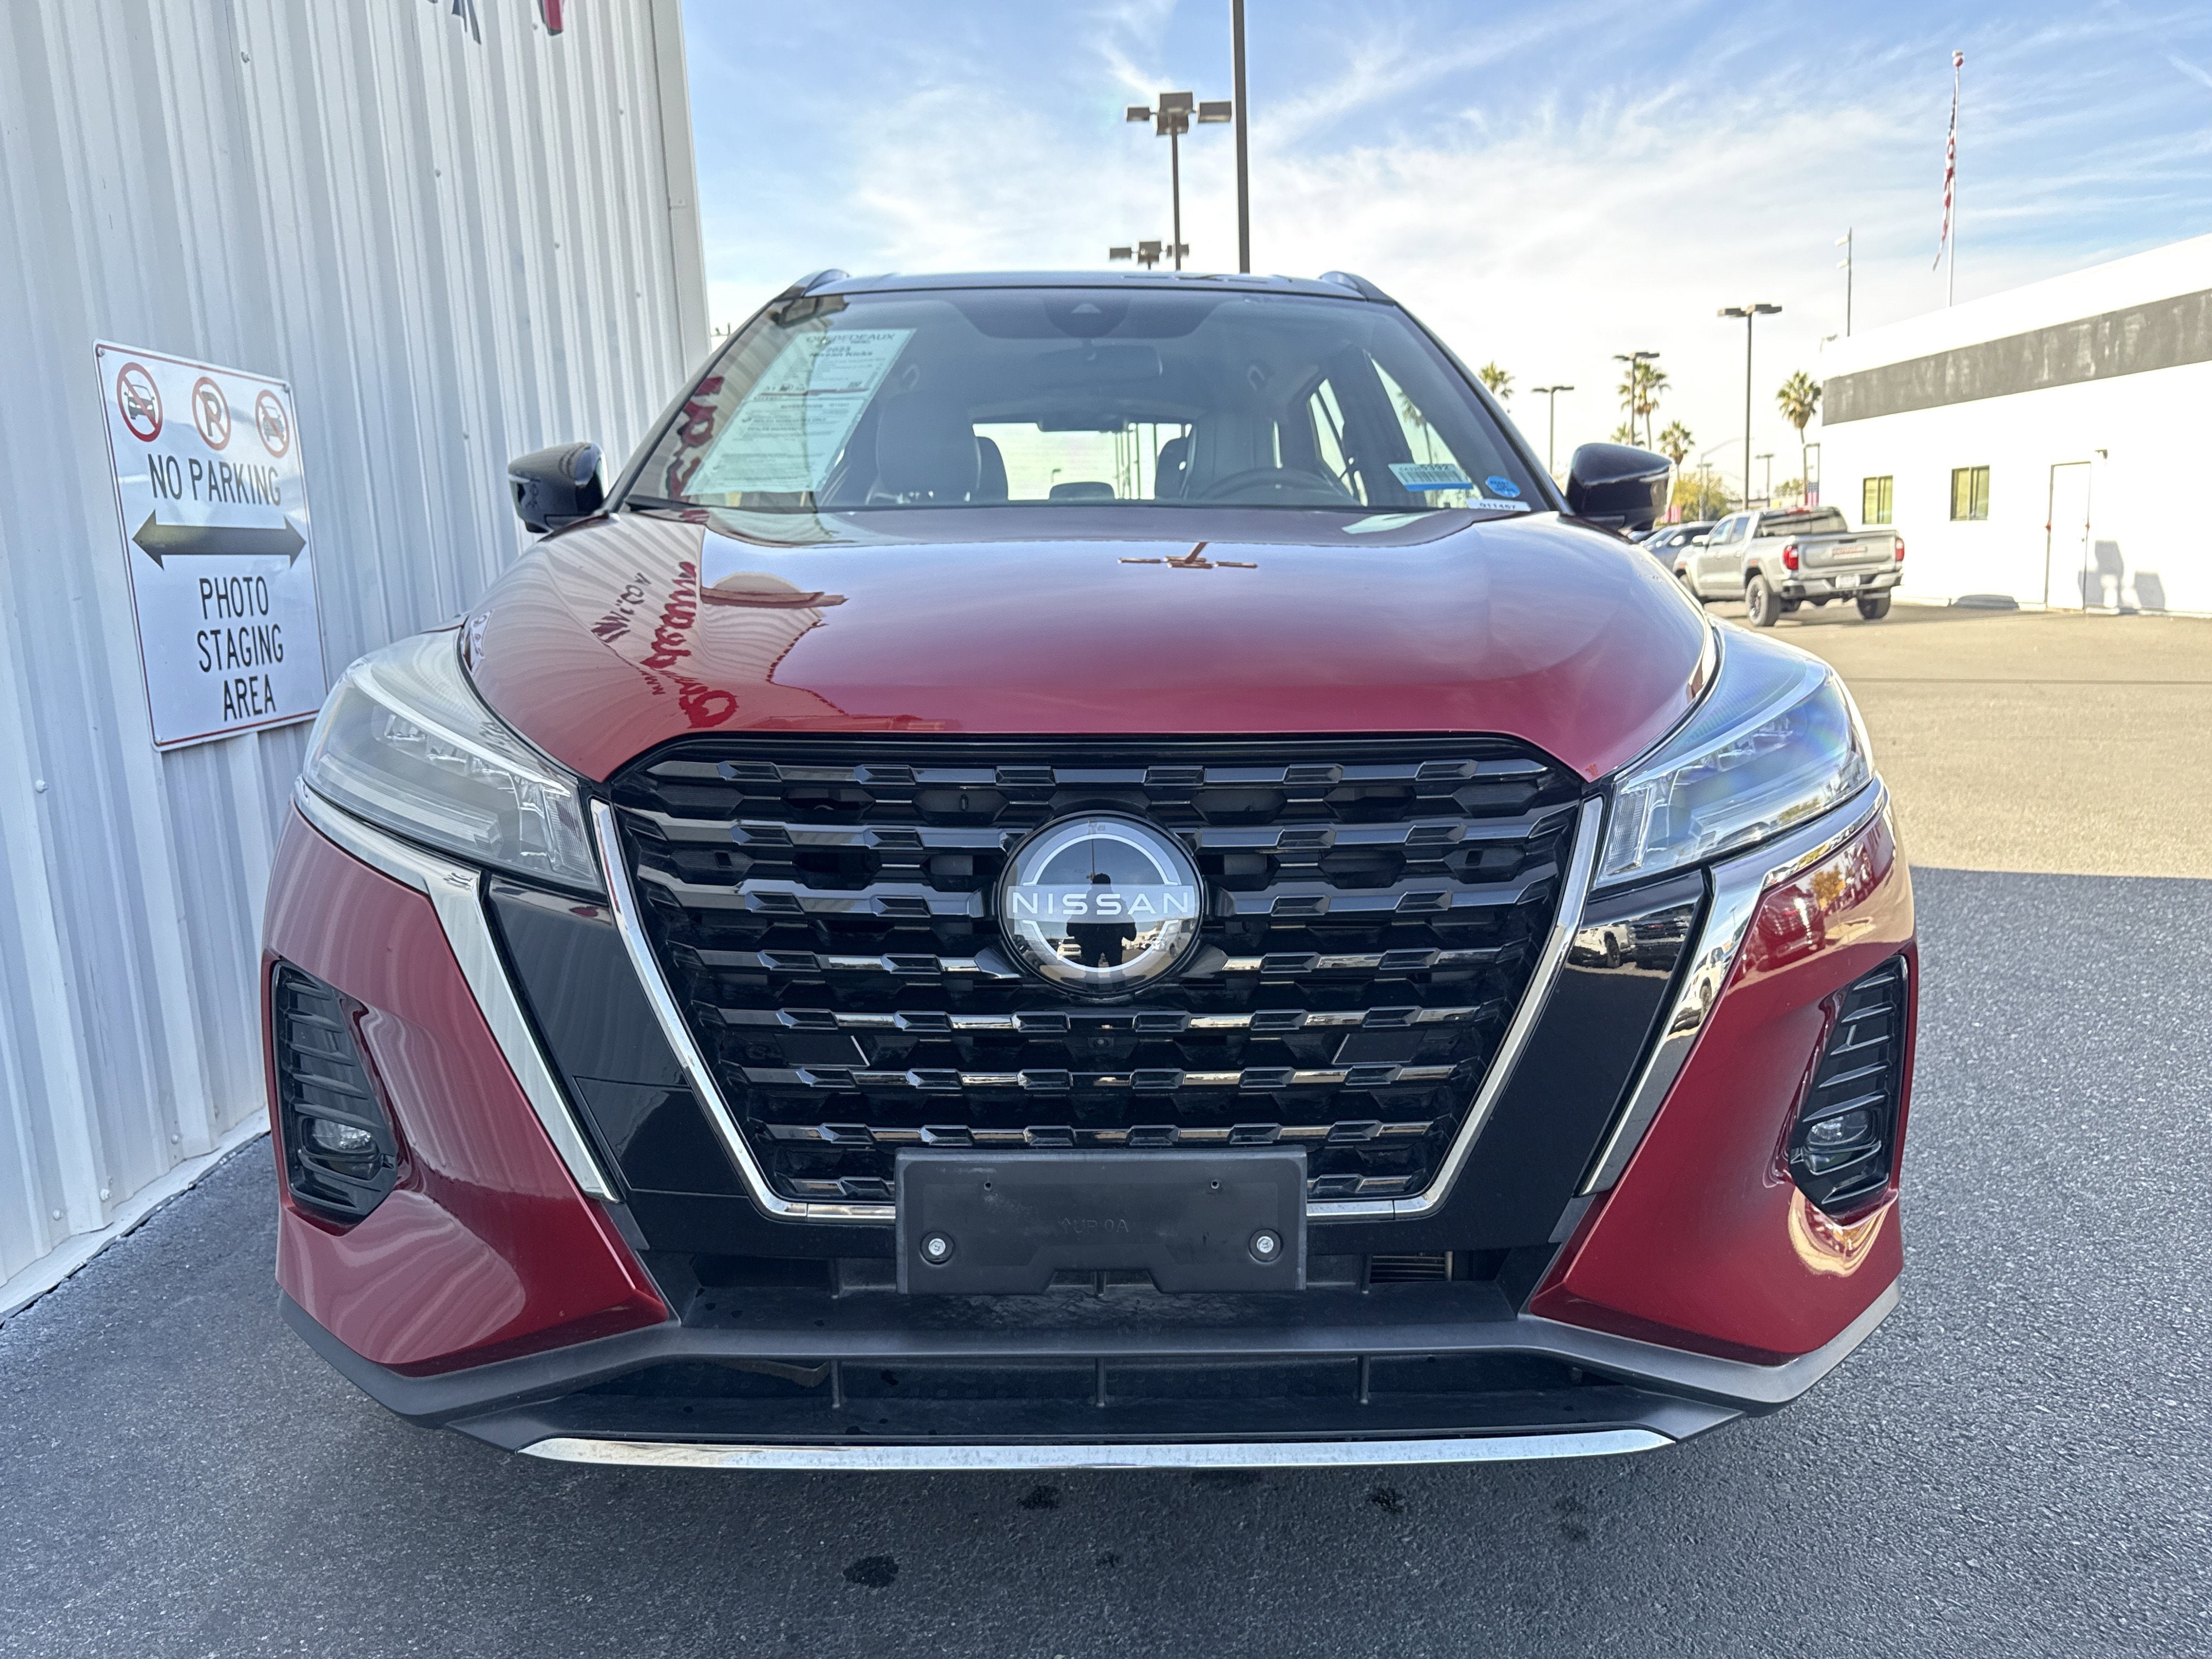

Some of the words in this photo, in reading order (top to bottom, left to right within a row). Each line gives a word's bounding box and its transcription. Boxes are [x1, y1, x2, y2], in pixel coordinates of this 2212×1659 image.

[148, 454, 183, 500] NO
[188, 458, 281, 506] PARKING
[199, 575, 269, 619] PHOTO
[197, 623, 284, 673] STAGING
[224, 674, 276, 722] AREA
[1012, 892, 1188, 916] NISSAN
